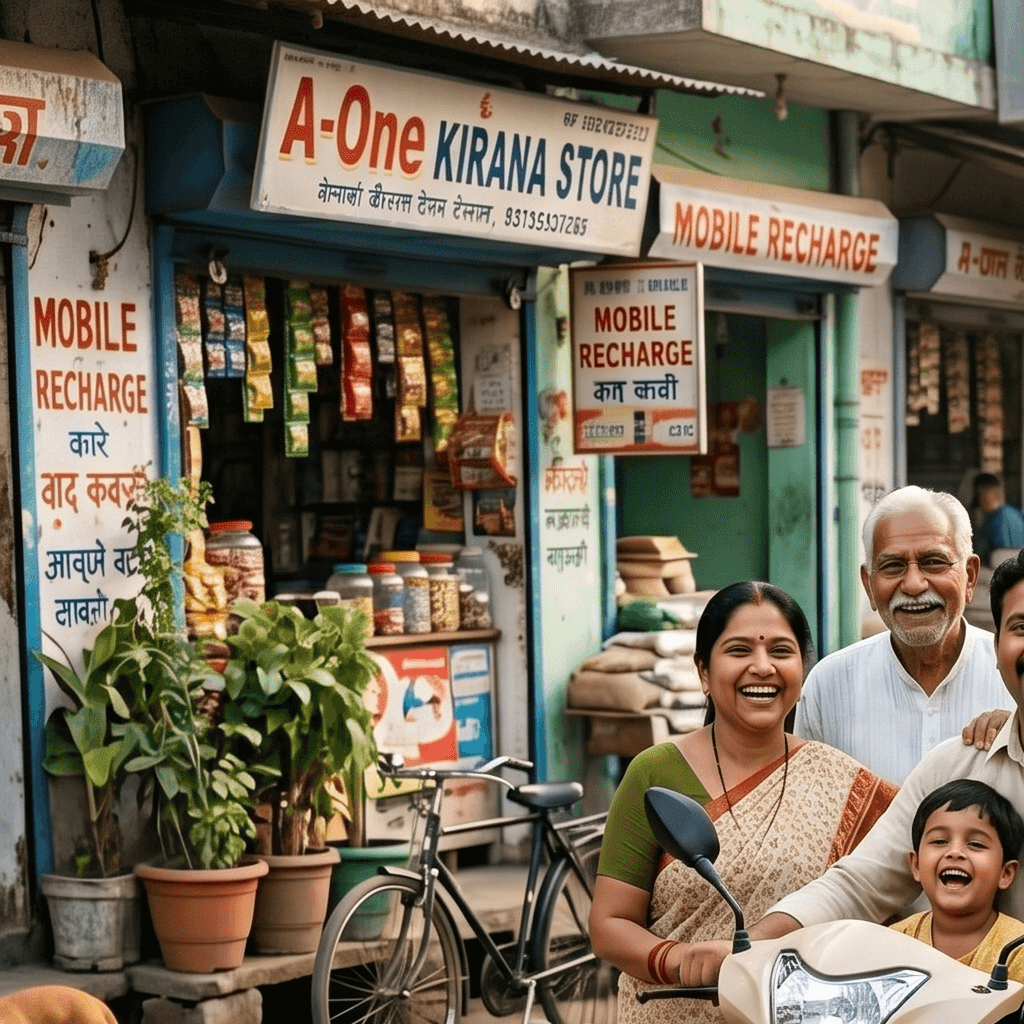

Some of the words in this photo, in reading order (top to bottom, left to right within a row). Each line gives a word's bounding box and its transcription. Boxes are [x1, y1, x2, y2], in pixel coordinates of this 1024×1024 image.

[279, 76, 426, 176] A-One
[433, 120, 546, 197] KIRANA
[556, 142, 642, 210] STORE
[673, 202, 760, 256] MOBILE
[766, 217, 880, 273] RECHARGE
[34, 296, 137, 352] MOBILE
[595, 305, 676, 332] MOBILE
[580, 340, 693, 368] RECHARGE
[36, 369, 148, 414] RECHARGE
